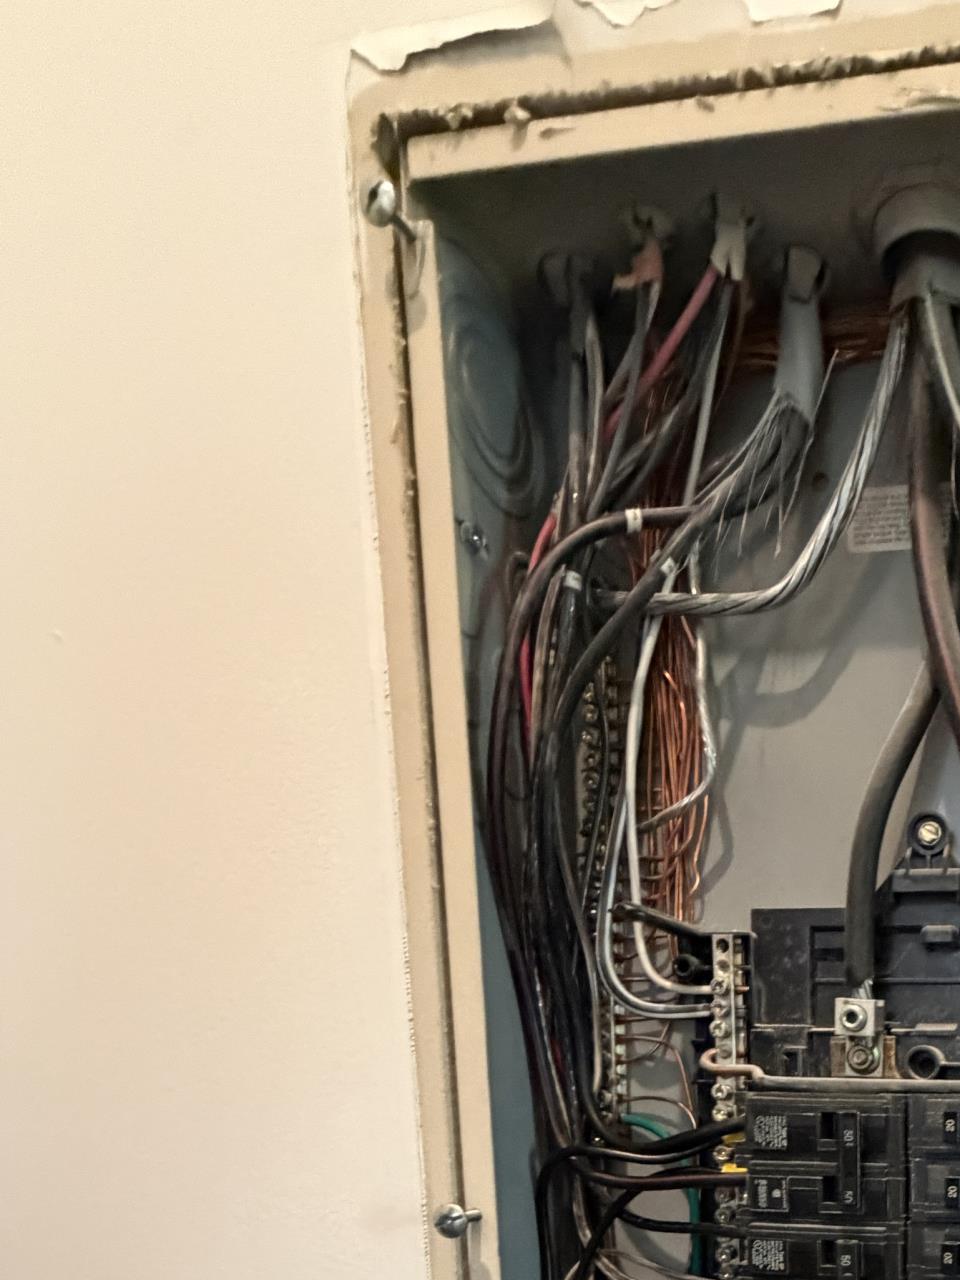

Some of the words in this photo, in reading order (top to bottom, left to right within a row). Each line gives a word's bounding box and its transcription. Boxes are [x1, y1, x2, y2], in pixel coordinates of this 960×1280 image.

[945, 1119, 956, 1132] 20
[947, 1185, 958, 1198] 20
[943, 1252, 953, 1264] 20
